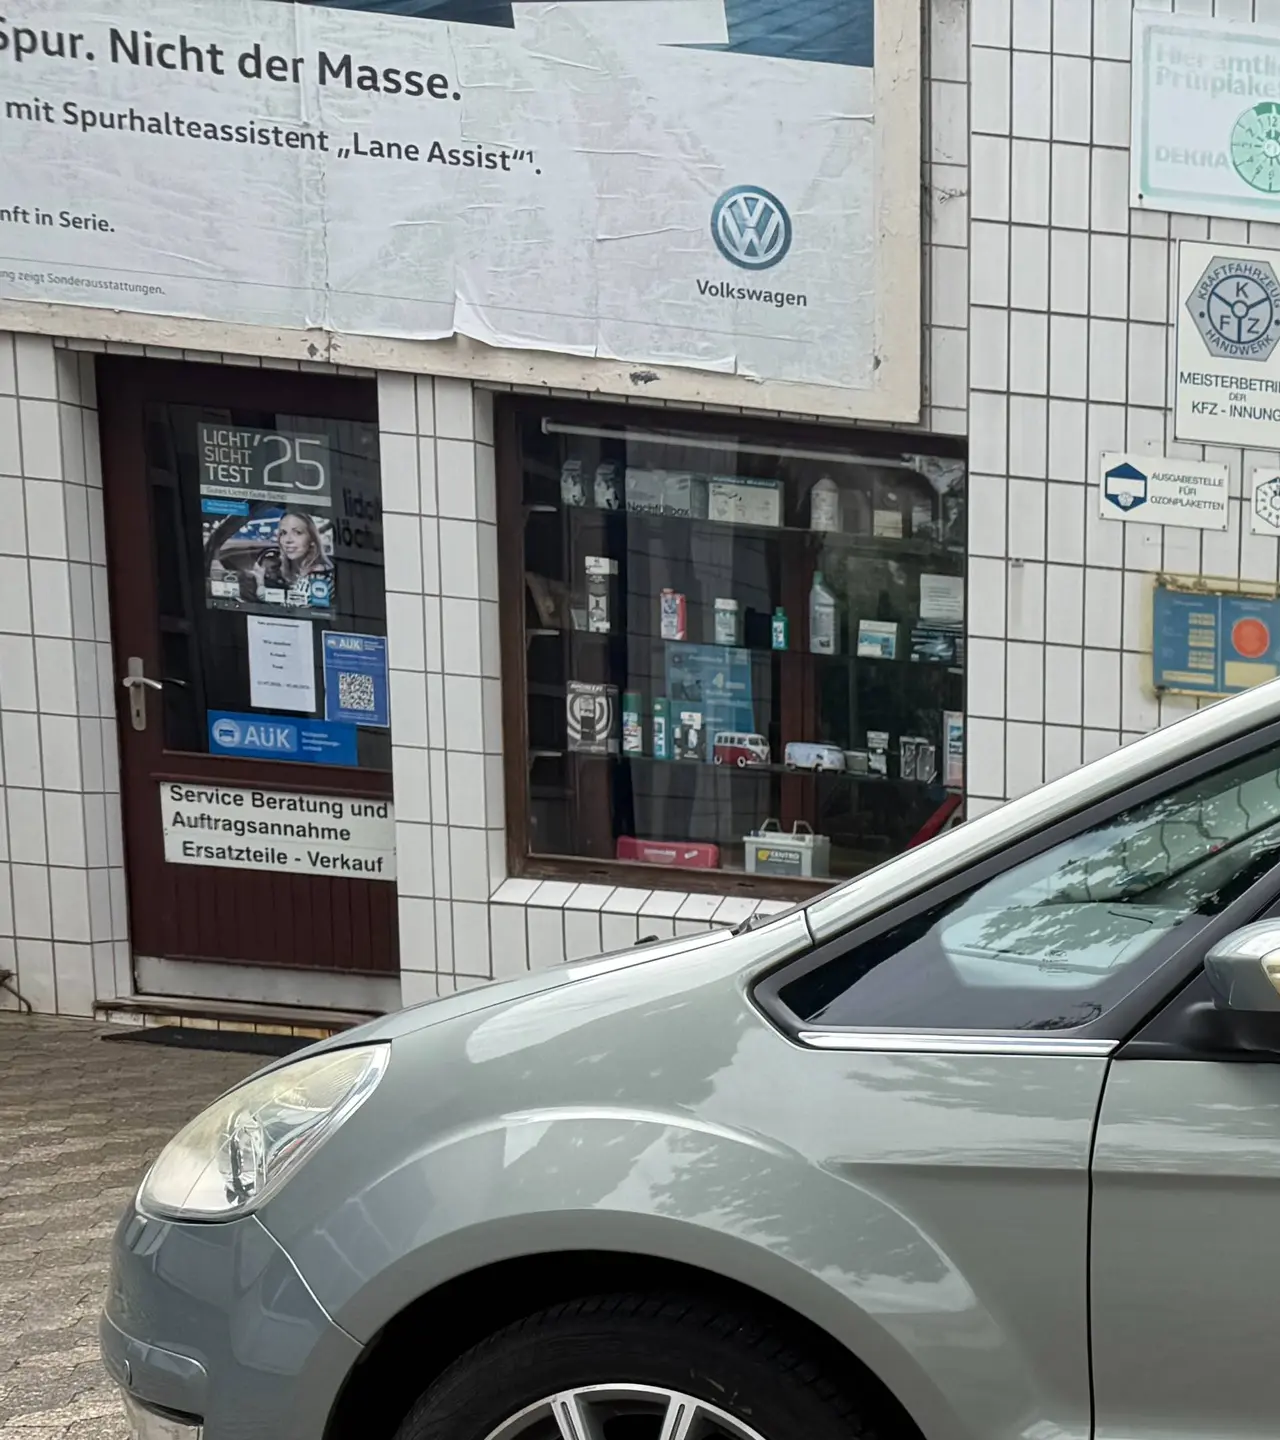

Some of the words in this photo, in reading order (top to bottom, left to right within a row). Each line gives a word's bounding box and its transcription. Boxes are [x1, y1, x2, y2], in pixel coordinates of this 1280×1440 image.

[109, 28, 225, 75] Nicht
[238, 43, 305, 83] der
[317, 51, 461, 101] Masse.
[6, 97, 55, 123] mit
[63, 101, 329, 152] Spurhalteassistent
[1154, 145, 1230, 172] DEKRA
[35, 208, 53, 226] in
[59, 211, 115, 233] Serie.
[18, 272, 45, 286] zeigt
[47, 273, 166, 296] Sonderausstattungen.
[696, 278, 807, 308] Volkswagen
[1235, 281, 1249, 299] K
[1219, 314, 1231, 331] F
[1247, 318, 1260, 334] Z
[1204, 329, 1274, 356] HANDWERK
[1191, 401, 1218, 415] KFZ
[1229, 392, 1247, 402] DER
[203, 429, 251, 448] LICHT
[204, 446, 252, 464] SICHT
[204, 463, 253, 484] TEST
[1151, 471, 1225, 488] AUSGABESTELLE
[1179, 486, 1197, 497] FÜR
[1150, 495, 1225, 511] OZONPLAKETTEN
[170, 785, 244, 807] Service
[251, 792, 343, 819] Beratung
[351, 802, 388, 819] und
[172, 811, 351, 841] Auftragsannahme
[182, 841, 288, 865] Ersatzteile
[307, 850, 383, 873] Verkauf
